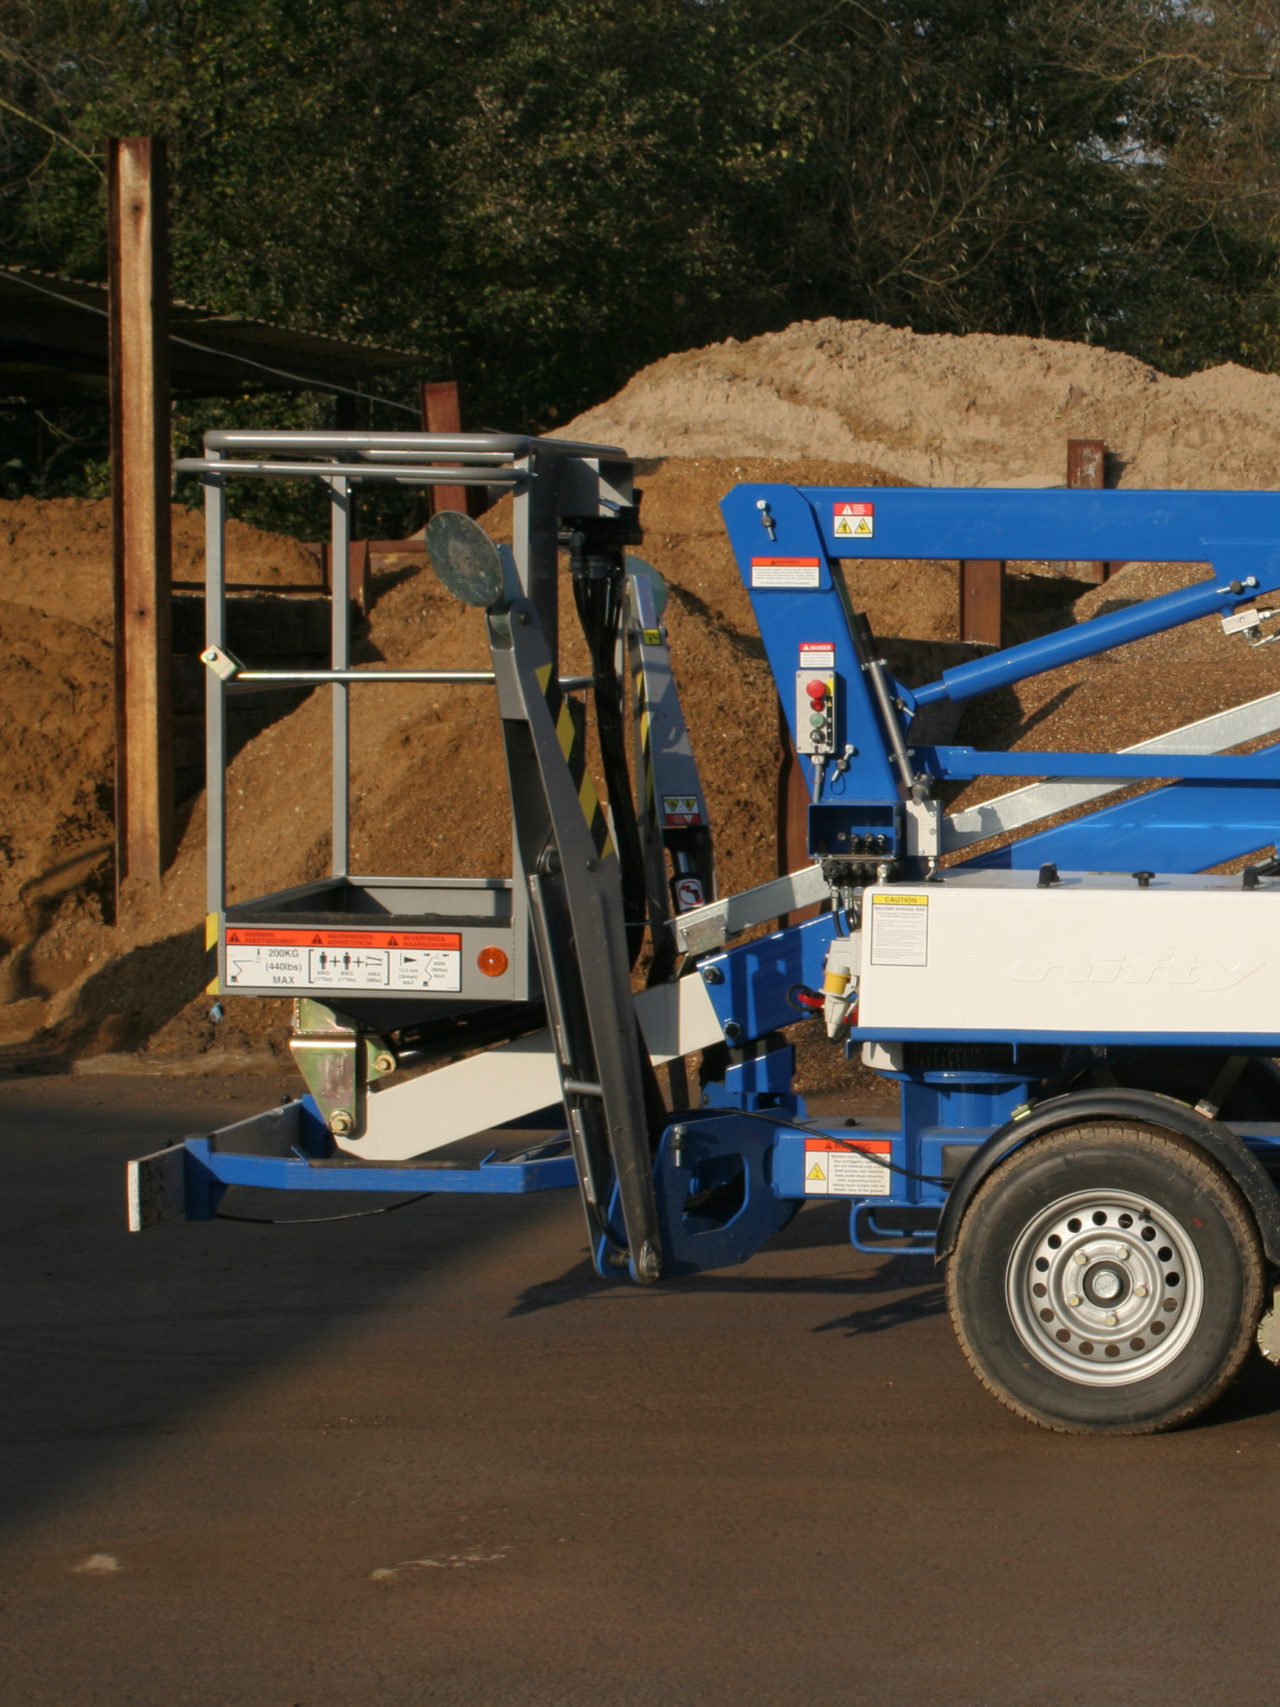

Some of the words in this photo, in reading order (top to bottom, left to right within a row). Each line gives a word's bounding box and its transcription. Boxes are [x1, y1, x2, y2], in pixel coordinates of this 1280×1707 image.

[268, 949, 299, 958] 200KG
[265, 962, 302, 973] (440lbs)
[272, 976, 296, 984] MAX
